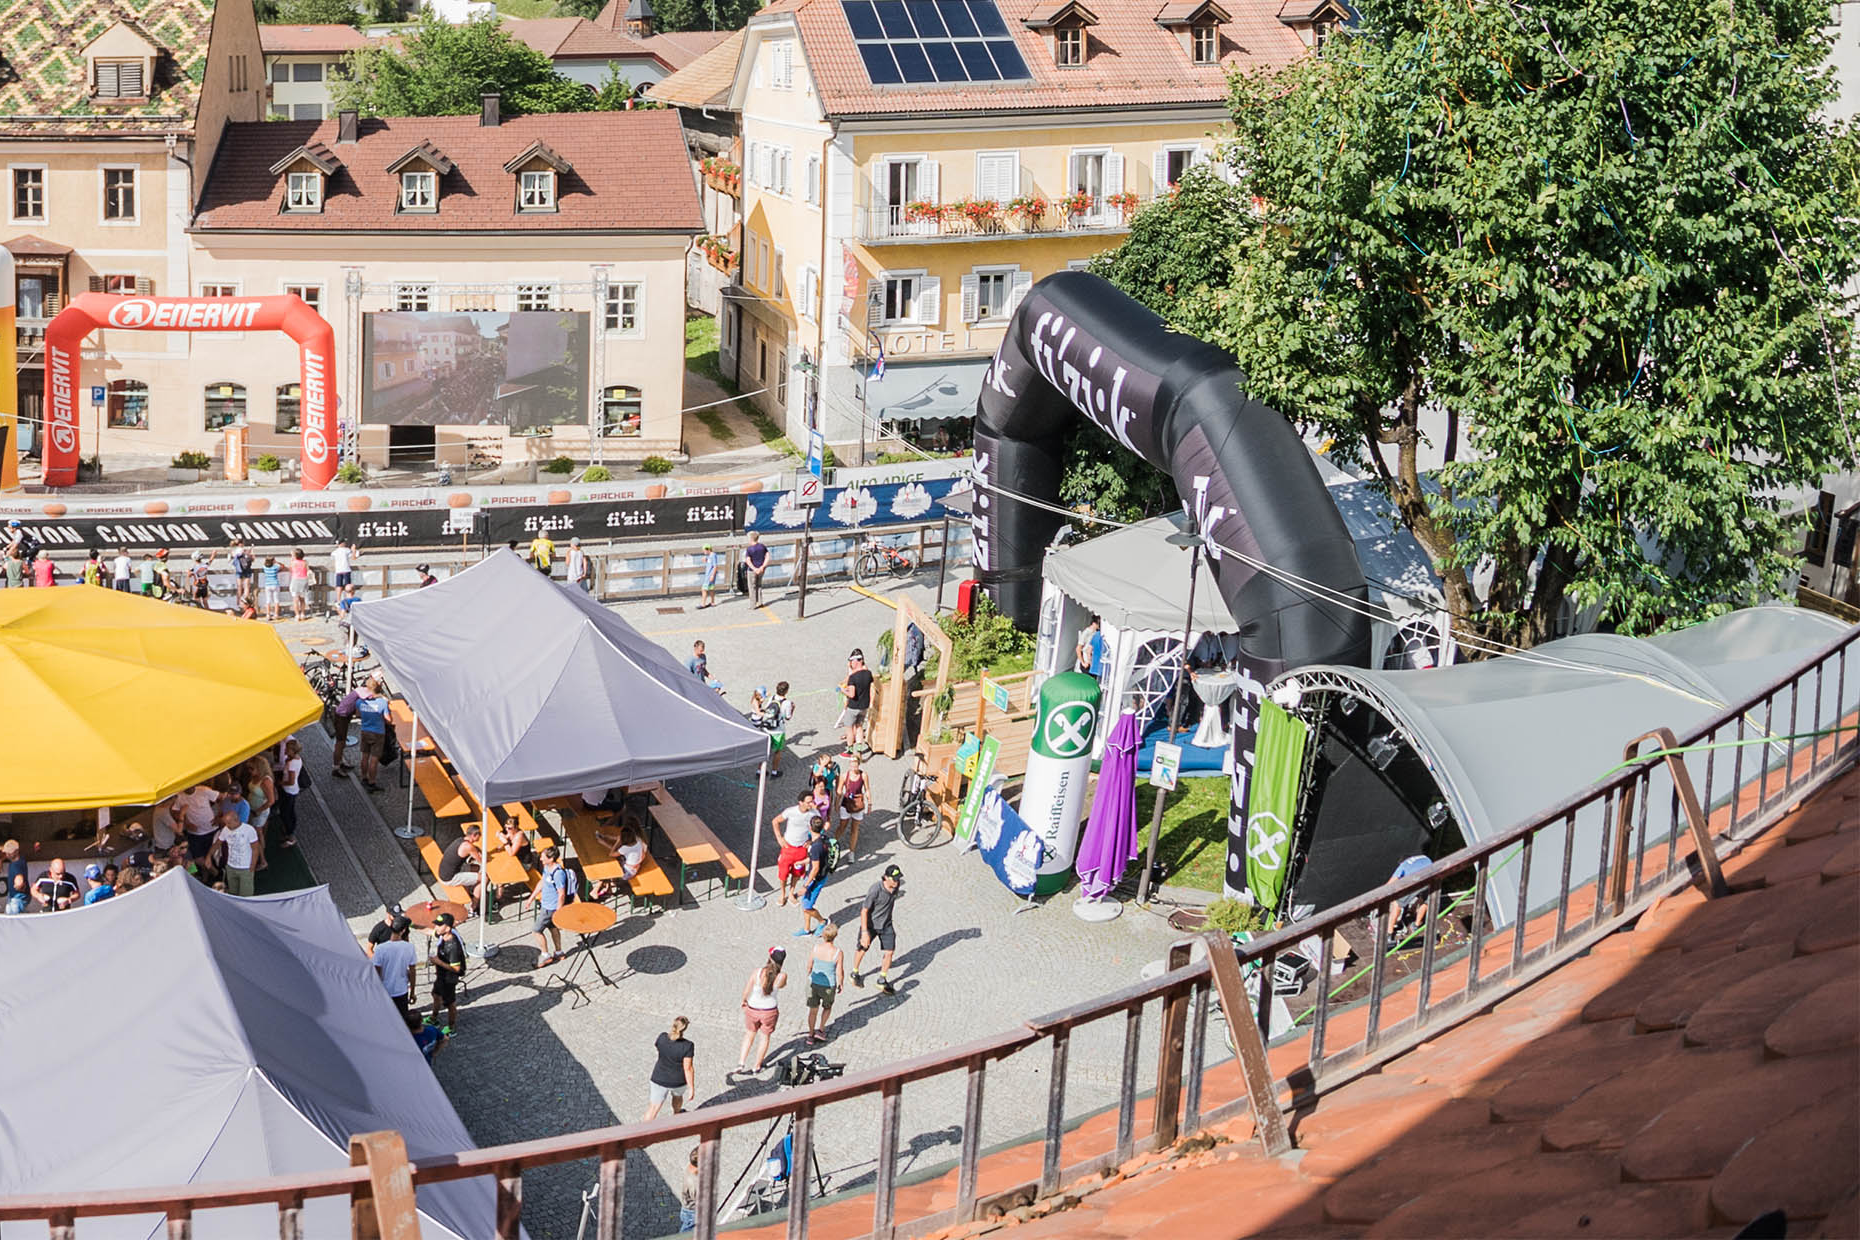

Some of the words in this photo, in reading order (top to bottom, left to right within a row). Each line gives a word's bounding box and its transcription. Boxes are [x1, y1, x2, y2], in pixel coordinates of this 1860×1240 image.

[154, 302, 263, 327] ENERVIT
[867, 333, 978, 355] HOTEL
[51, 346, 72, 427] ENERVIT
[93, 388, 103, 399] P
[304, 348, 325, 432] ENERVIT
[1030, 311, 1148, 459] fi'zi:k
[589, 491, 634, 501] PIRCHER
[686, 487, 730, 496] PIRCHER
[188, 504, 235, 512] PIRCHER
[290, 501, 336, 510] PIRCHER
[391, 498, 436, 507] PIRCHER
[491, 496, 537, 505] PIRCHER
[606, 511, 656, 527] fi'zi:k
[687, 505, 735, 522] fi'zi:k
[221, 520, 335, 540] CANYON
[357, 521, 409, 538] fi'zi:k
[524, 515, 574, 532] fi'zi:k
[95, 523, 209, 543] CANYON
[1045, 769, 1071, 841] Raiffeisen
